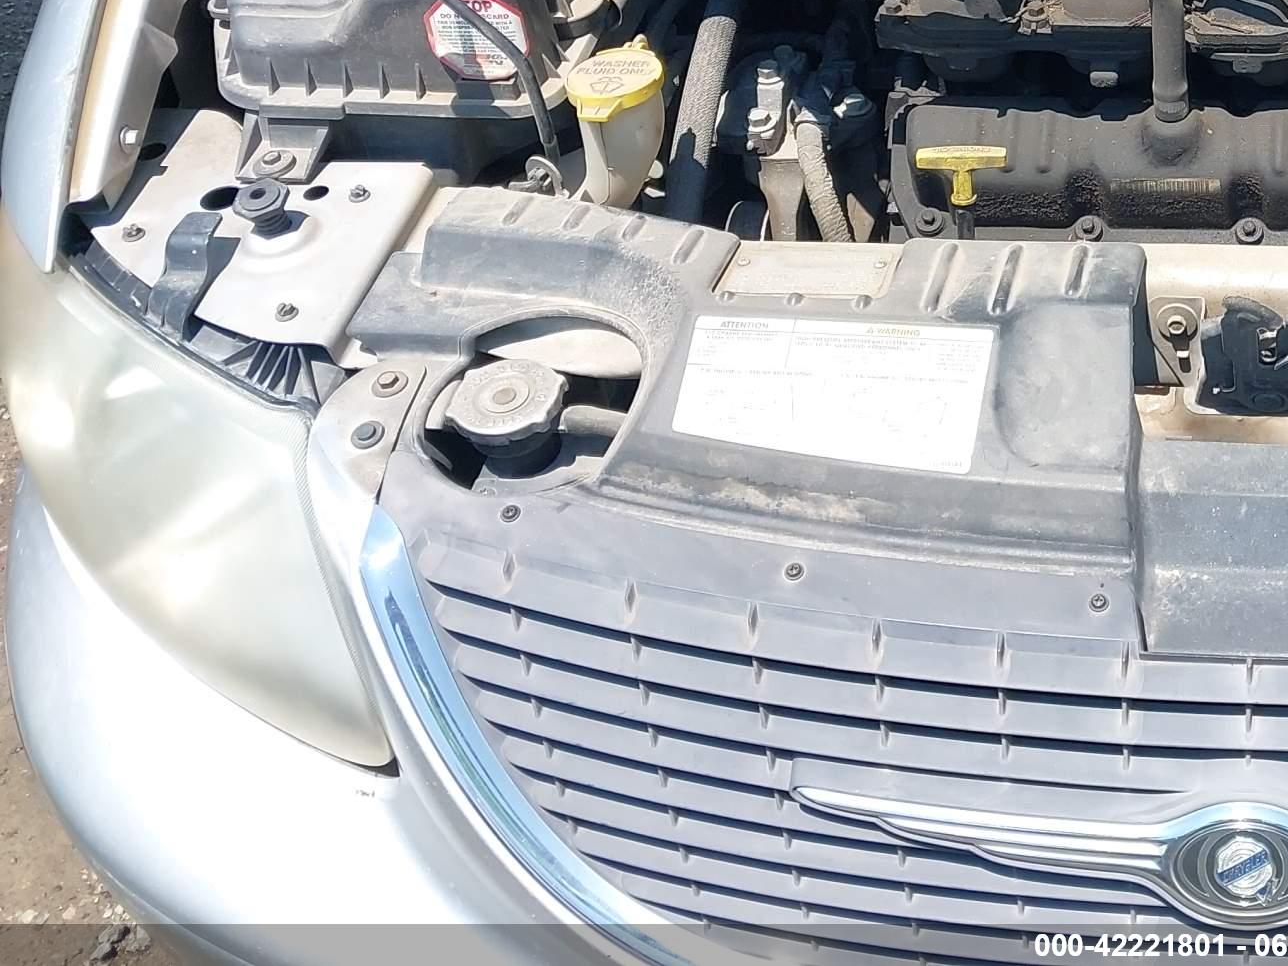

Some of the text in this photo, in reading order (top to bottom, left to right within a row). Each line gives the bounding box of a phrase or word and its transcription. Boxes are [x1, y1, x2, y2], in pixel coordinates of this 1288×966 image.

[592, 59, 650, 68] WASHER
[576, 67, 657, 76] FLUID ONLY
[720, 320, 769, 330] ATTENTION
[877, 328, 921, 338] WARNING
